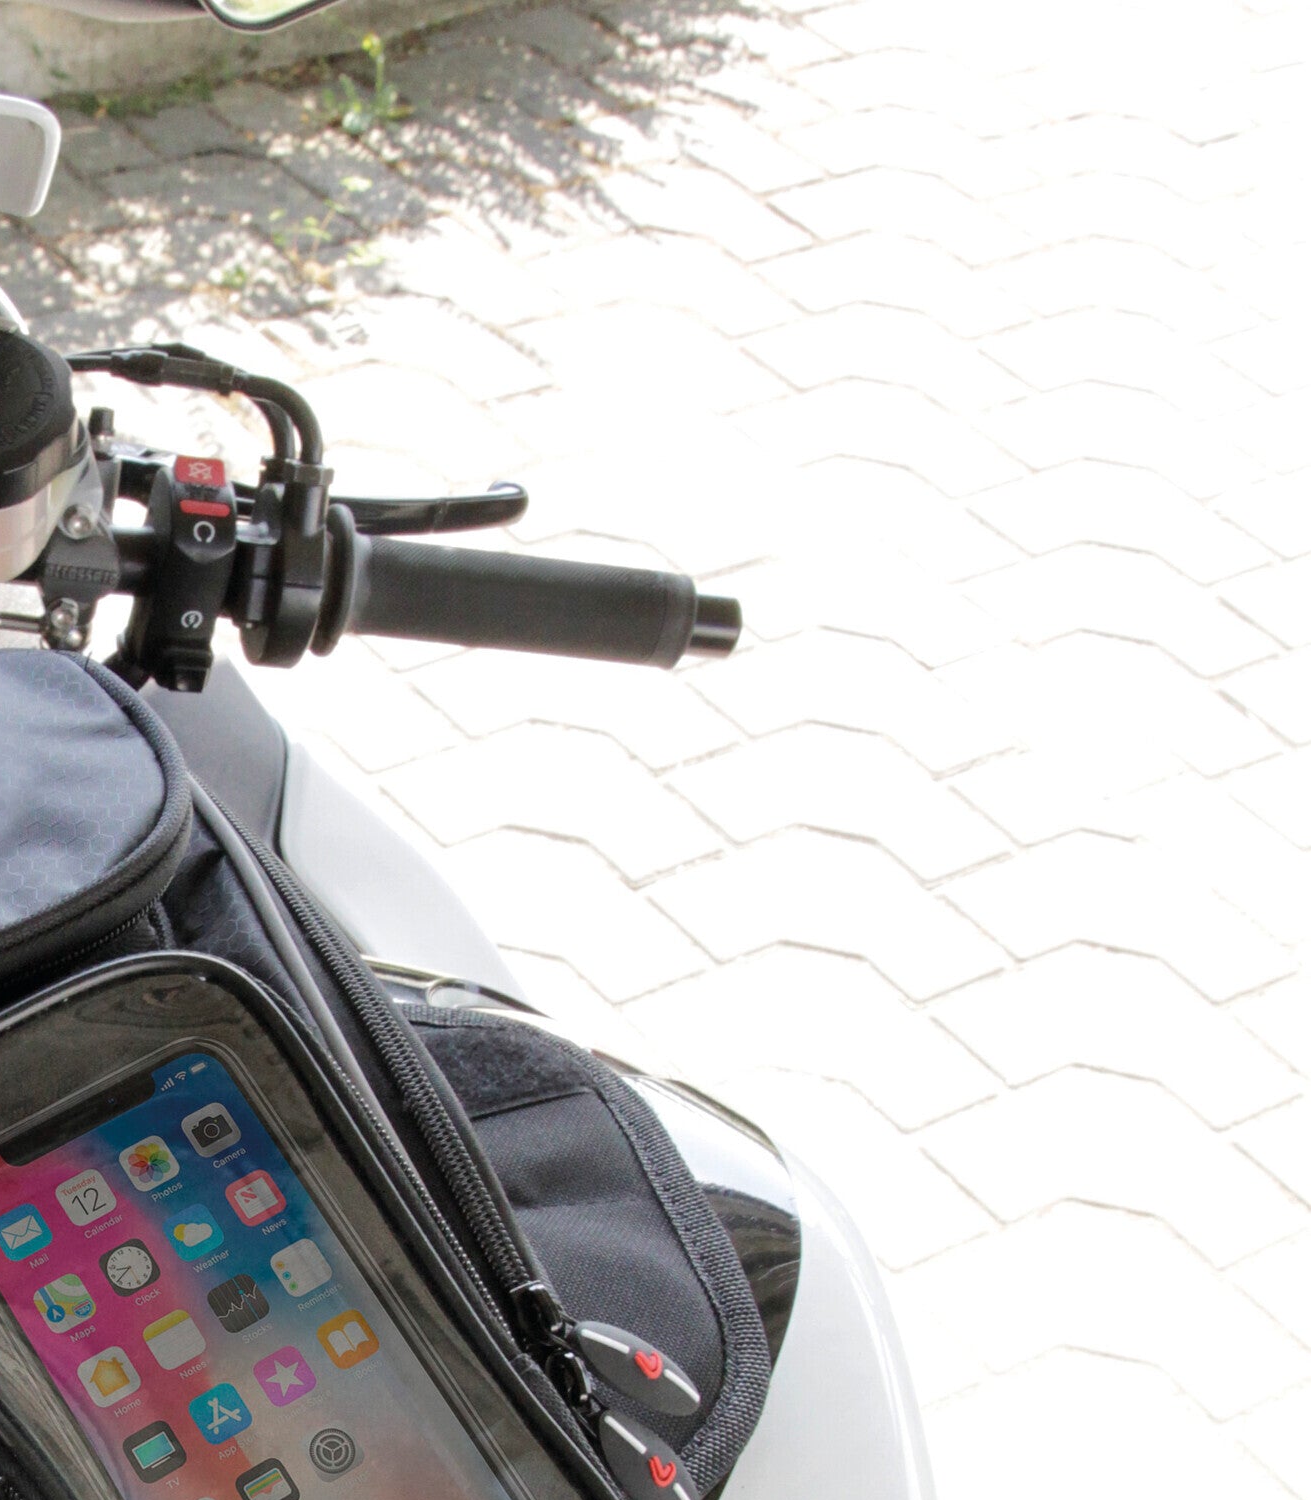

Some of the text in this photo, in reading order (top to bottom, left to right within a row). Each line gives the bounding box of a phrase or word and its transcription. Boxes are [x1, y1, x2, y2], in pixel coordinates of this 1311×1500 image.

[211, 1147, 247, 1169] Camera
[61, 1174, 96, 1197] Tuesday
[150, 1181, 184, 1202] Photos
[71, 1187, 107, 1216] 12
[84, 1213, 123, 1239] Calendar
[261, 1217, 288, 1236] News
[28, 1254, 50, 1270] Mail
[192, 1249, 231, 1274] Weather
[134, 1287, 162, 1306] Clock
[296, 1280, 344, 1312] Reminders
[69, 1324, 96, 1344] Maps
[240, 1320, 273, 1344] Stocks
[178, 1360, 208, 1381] Notes
[114, 1397, 142, 1418] Home
[216, 1443, 238, 1461] App
[165, 1476, 181, 1490] TV
